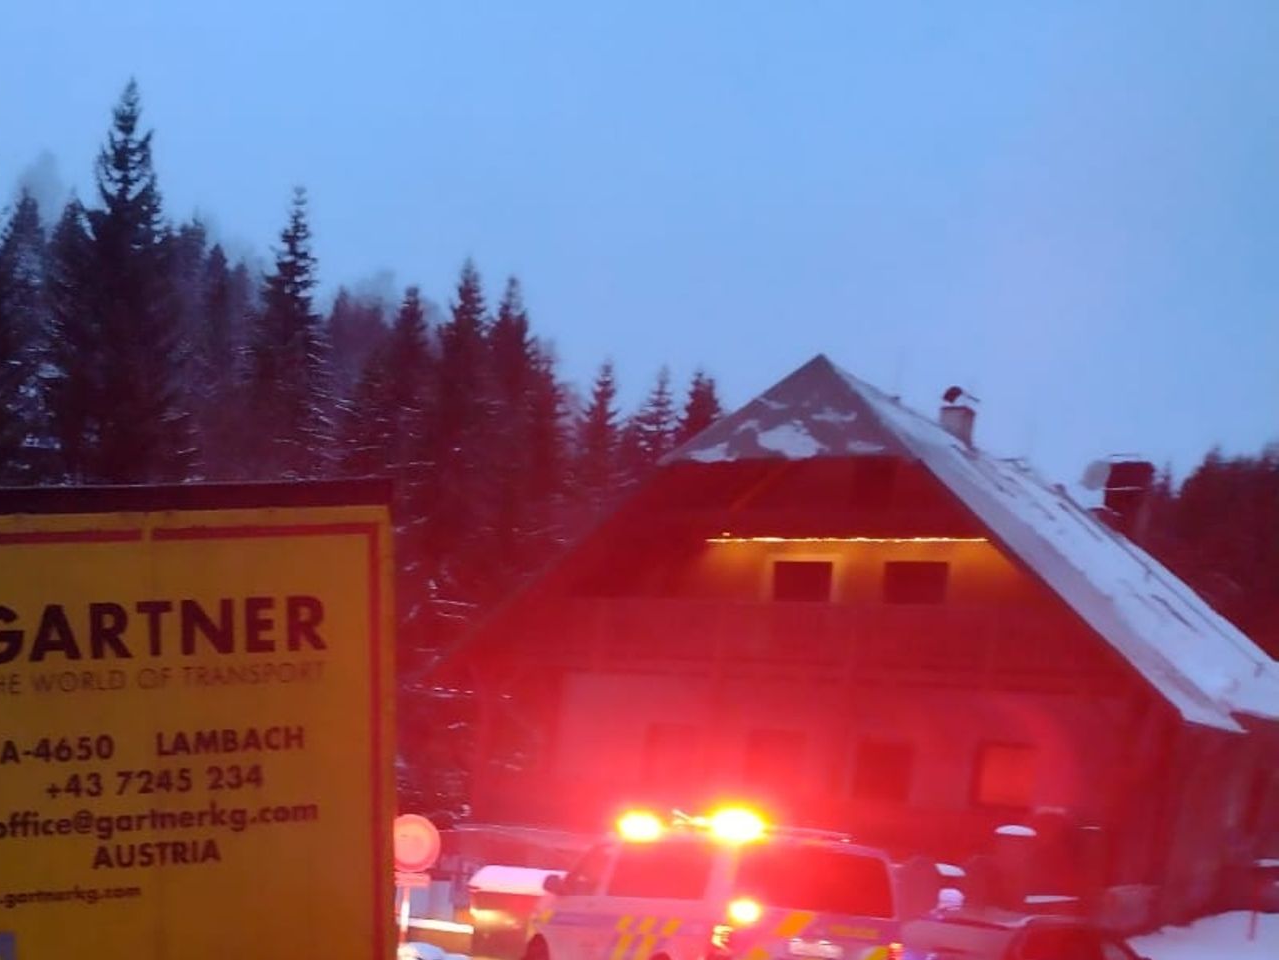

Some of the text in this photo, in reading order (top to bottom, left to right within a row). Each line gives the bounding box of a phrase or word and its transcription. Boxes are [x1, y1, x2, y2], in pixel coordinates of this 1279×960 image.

[33, 669, 126, 694] WORLD
[137, 667, 172, 690] OF
[182, 660, 327, 686] TRANSPORT
[0, 726, 304, 765] A-4650 LAMBACH
[46, 763, 264, 799] +43 7245 234
[92, 838, 221, 870] AUSTRIA
